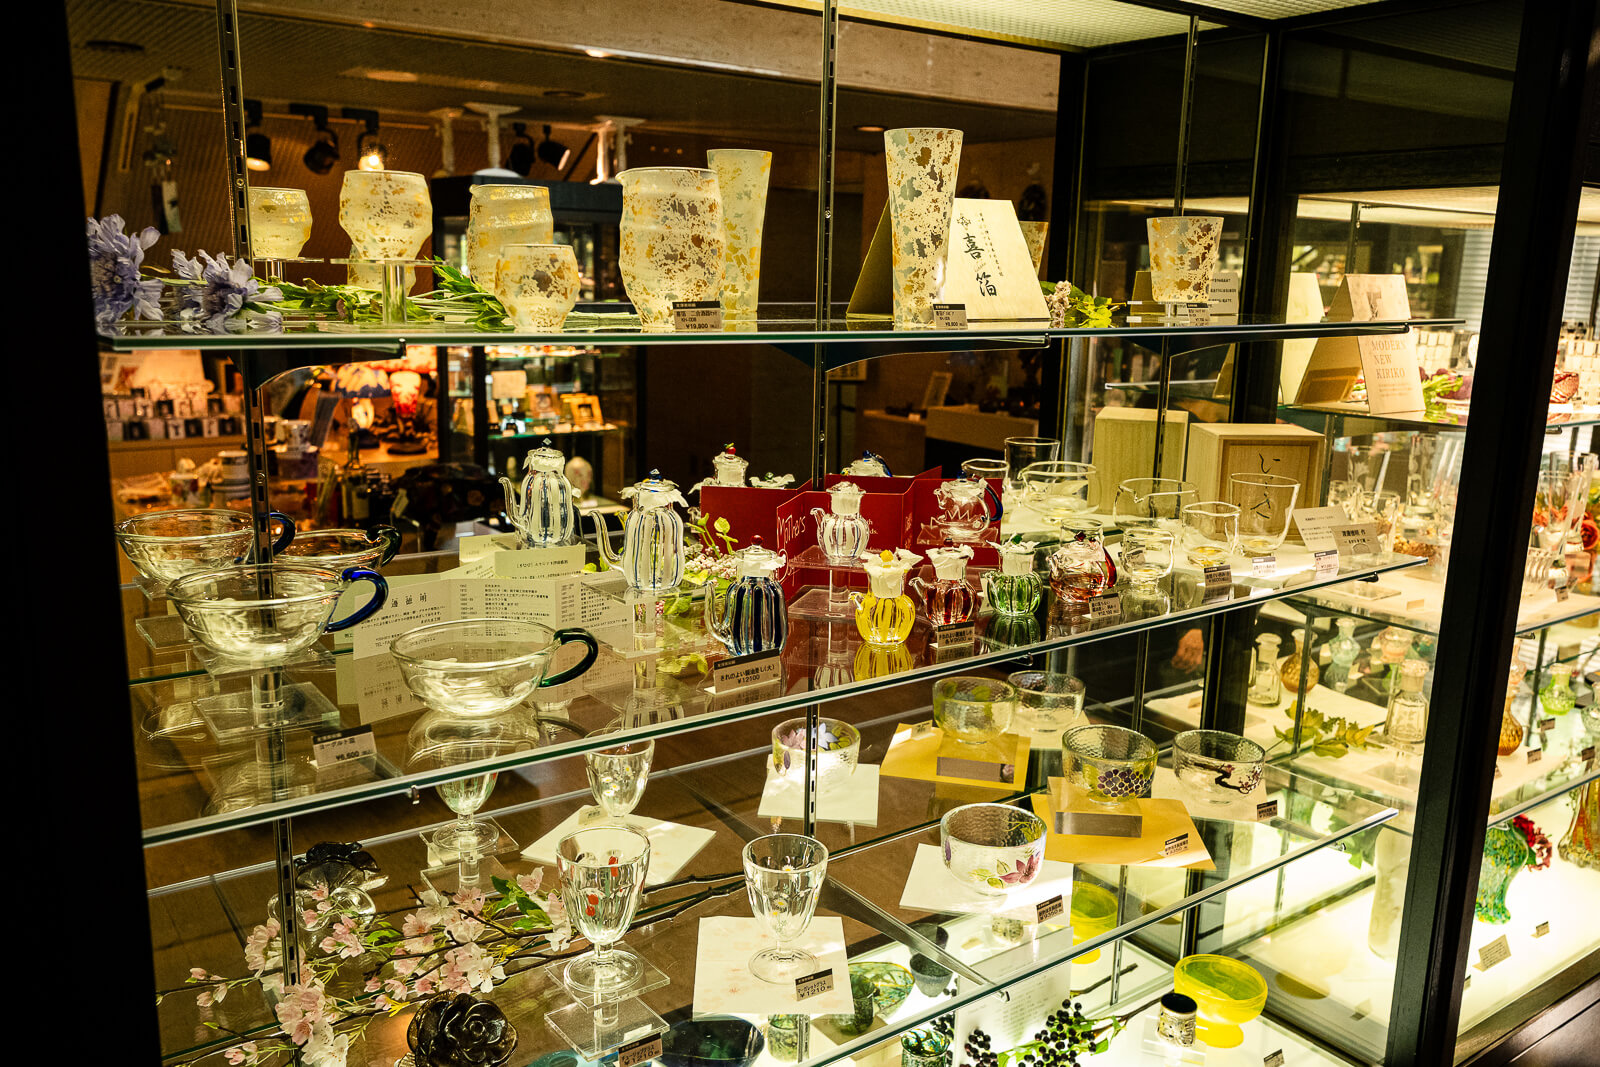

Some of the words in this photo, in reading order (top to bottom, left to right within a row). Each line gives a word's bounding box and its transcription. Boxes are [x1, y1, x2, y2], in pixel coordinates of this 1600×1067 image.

[1371, 340, 1407, 351] MODERN
[1373, 354, 1392, 365] NEW
[1376, 367, 1406, 379] KIRIKO
